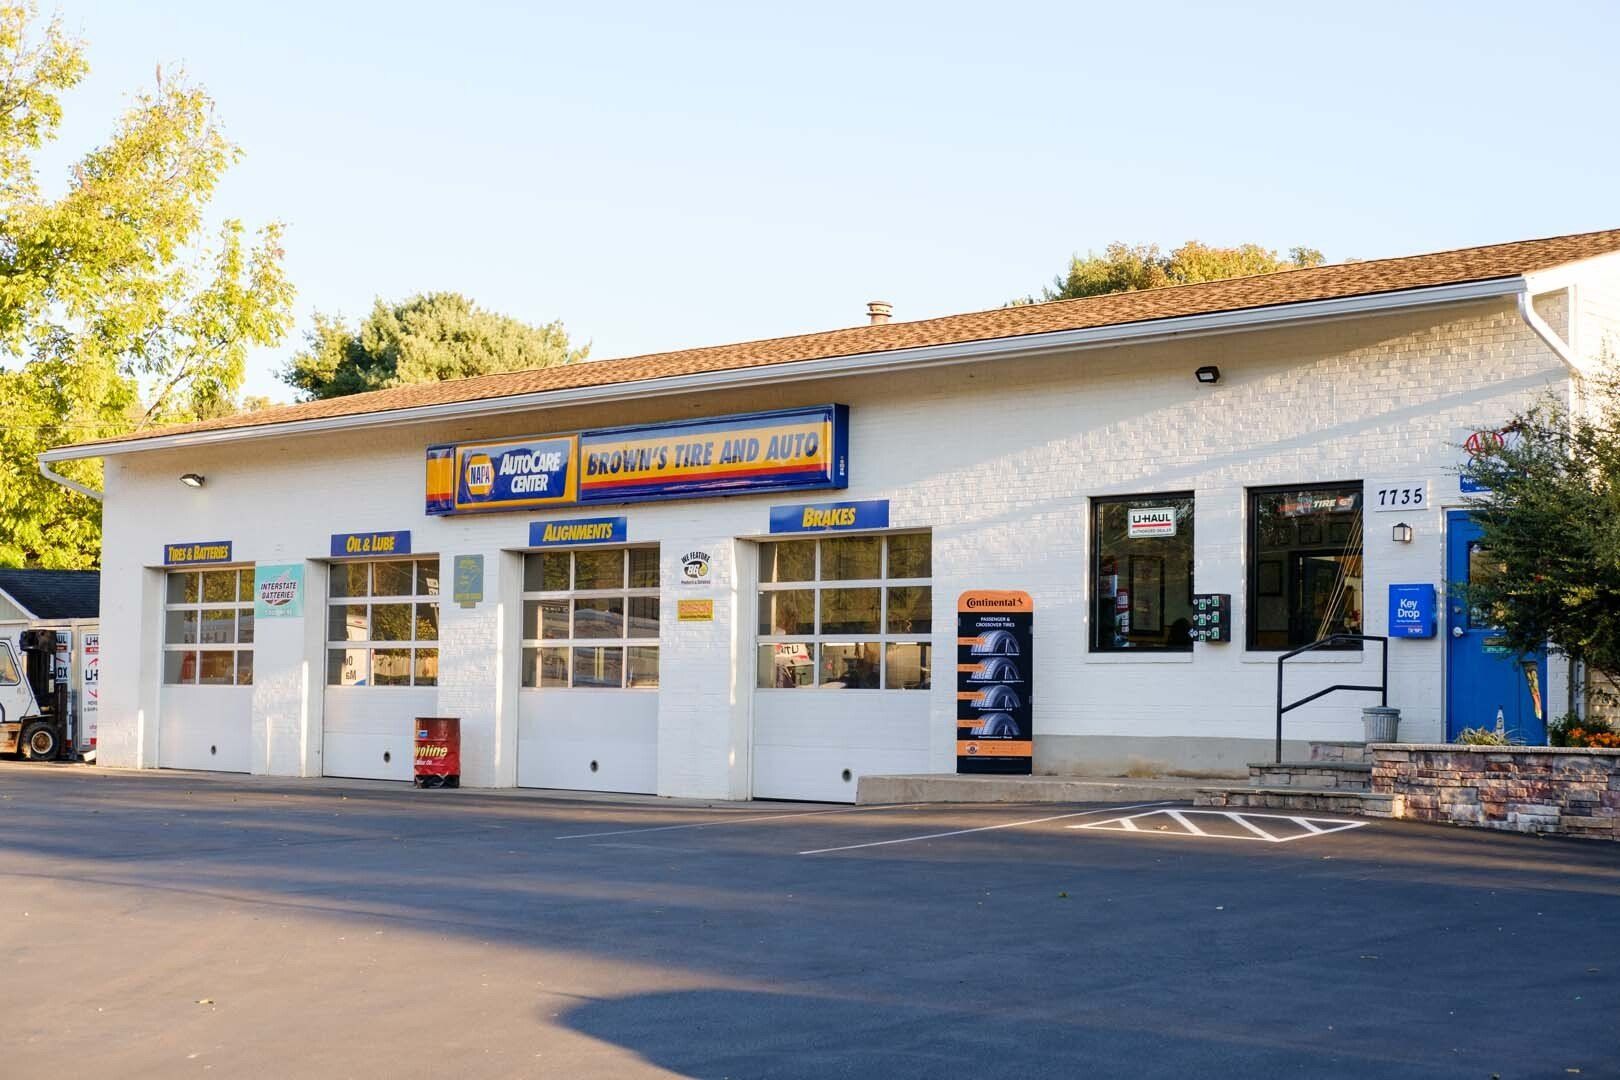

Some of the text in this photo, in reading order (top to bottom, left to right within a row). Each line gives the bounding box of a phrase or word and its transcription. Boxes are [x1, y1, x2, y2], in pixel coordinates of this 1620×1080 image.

[587, 432, 819, 476] BROWN'S TIRE AND AUTO
[470, 467, 491, 484] NAPA
[511, 474, 549, 493] CENTER
[1313, 499, 1337, 508] TIRE
[1378, 487, 1423, 506] 7735
[803, 507, 856, 527] BRAKES
[1132, 513, 1171, 523] U-HAUL
[543, 522, 613, 542] ALIGNMENTS
[346, 534, 396, 552] OIL & LUBE
[168, 544, 229, 561] TIRES & BATTERIES
[681, 551, 711, 564] WE FEATURE
[260, 582, 297, 590] INTERSTATE
[261, 591, 295, 599] BATTERIES
[966, 597, 1016, 608] Continental
[1400, 598, 1418, 610] Key
[1397, 608, 1420, 620] Drop
